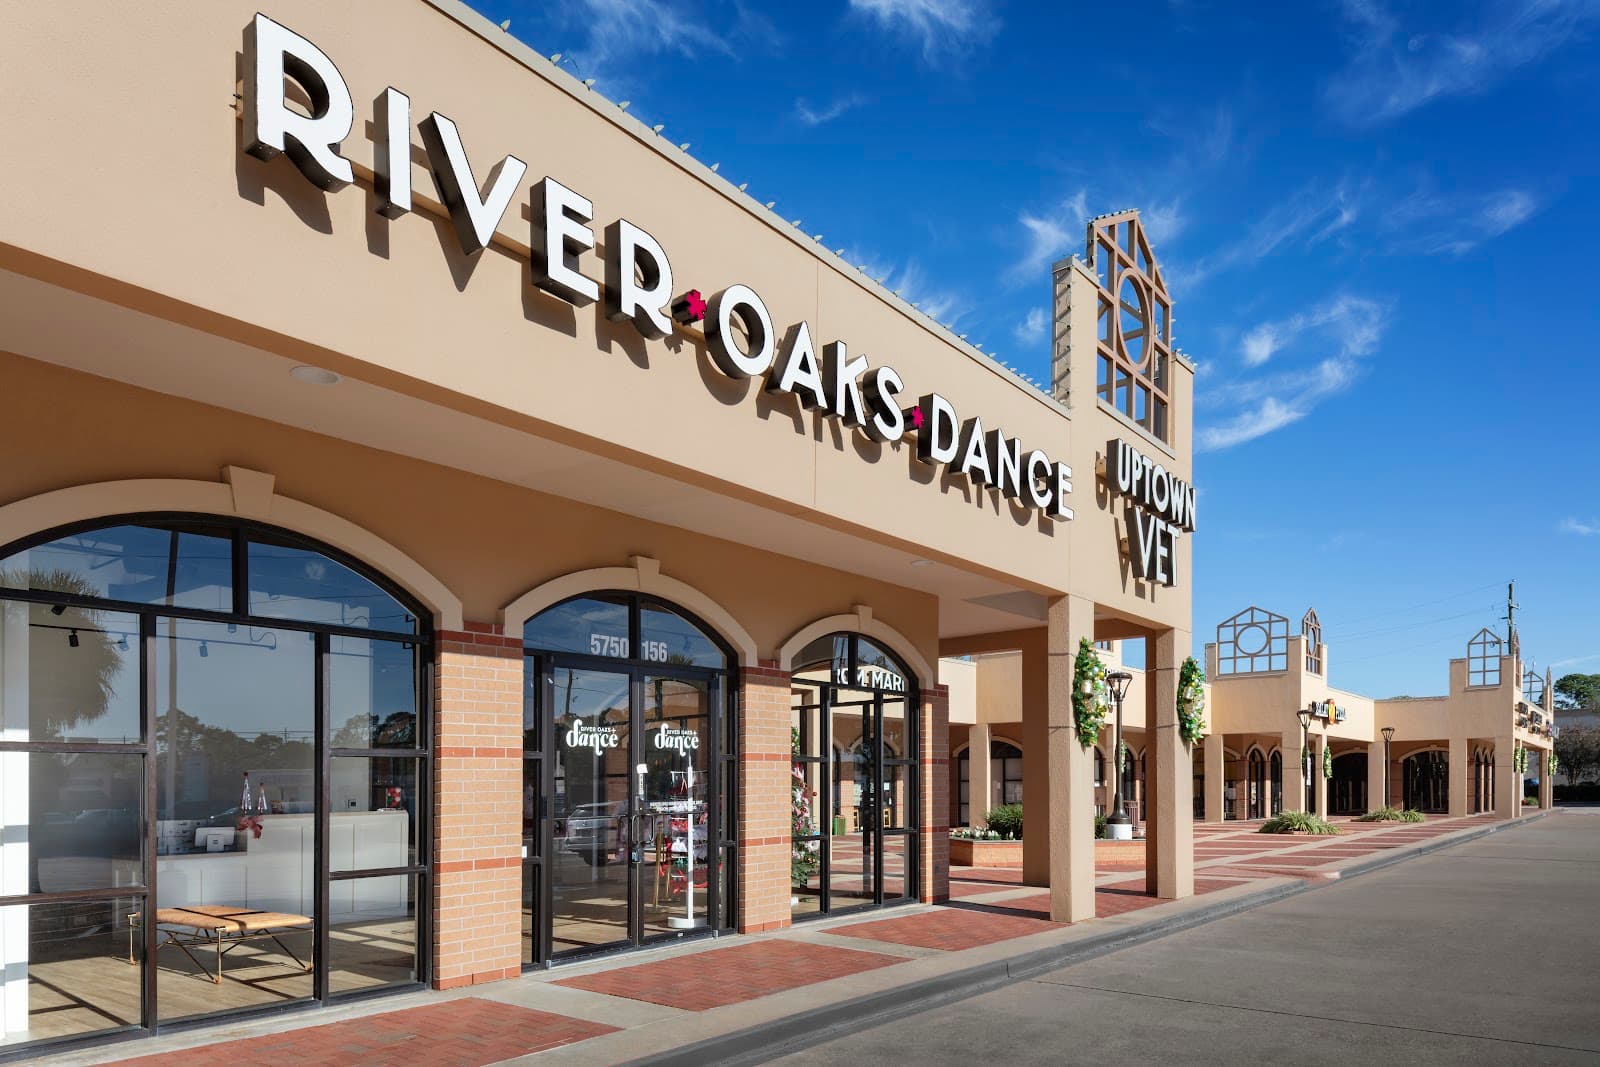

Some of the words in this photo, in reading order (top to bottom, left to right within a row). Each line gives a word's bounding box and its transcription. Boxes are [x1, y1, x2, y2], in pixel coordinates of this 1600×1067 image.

[255, 12, 674, 336] RIVER
[717, 284, 905, 442] OAKS
[931, 392, 1075, 521] DANCE
[1117, 437, 1196, 533] UPTOWN
[1135, 504, 1180, 588] VET
[590, 633, 630, 659] 5750
[641, 640, 668, 662] 156
[565, 718, 619, 756] dance
[654, 722, 699, 757] dance
